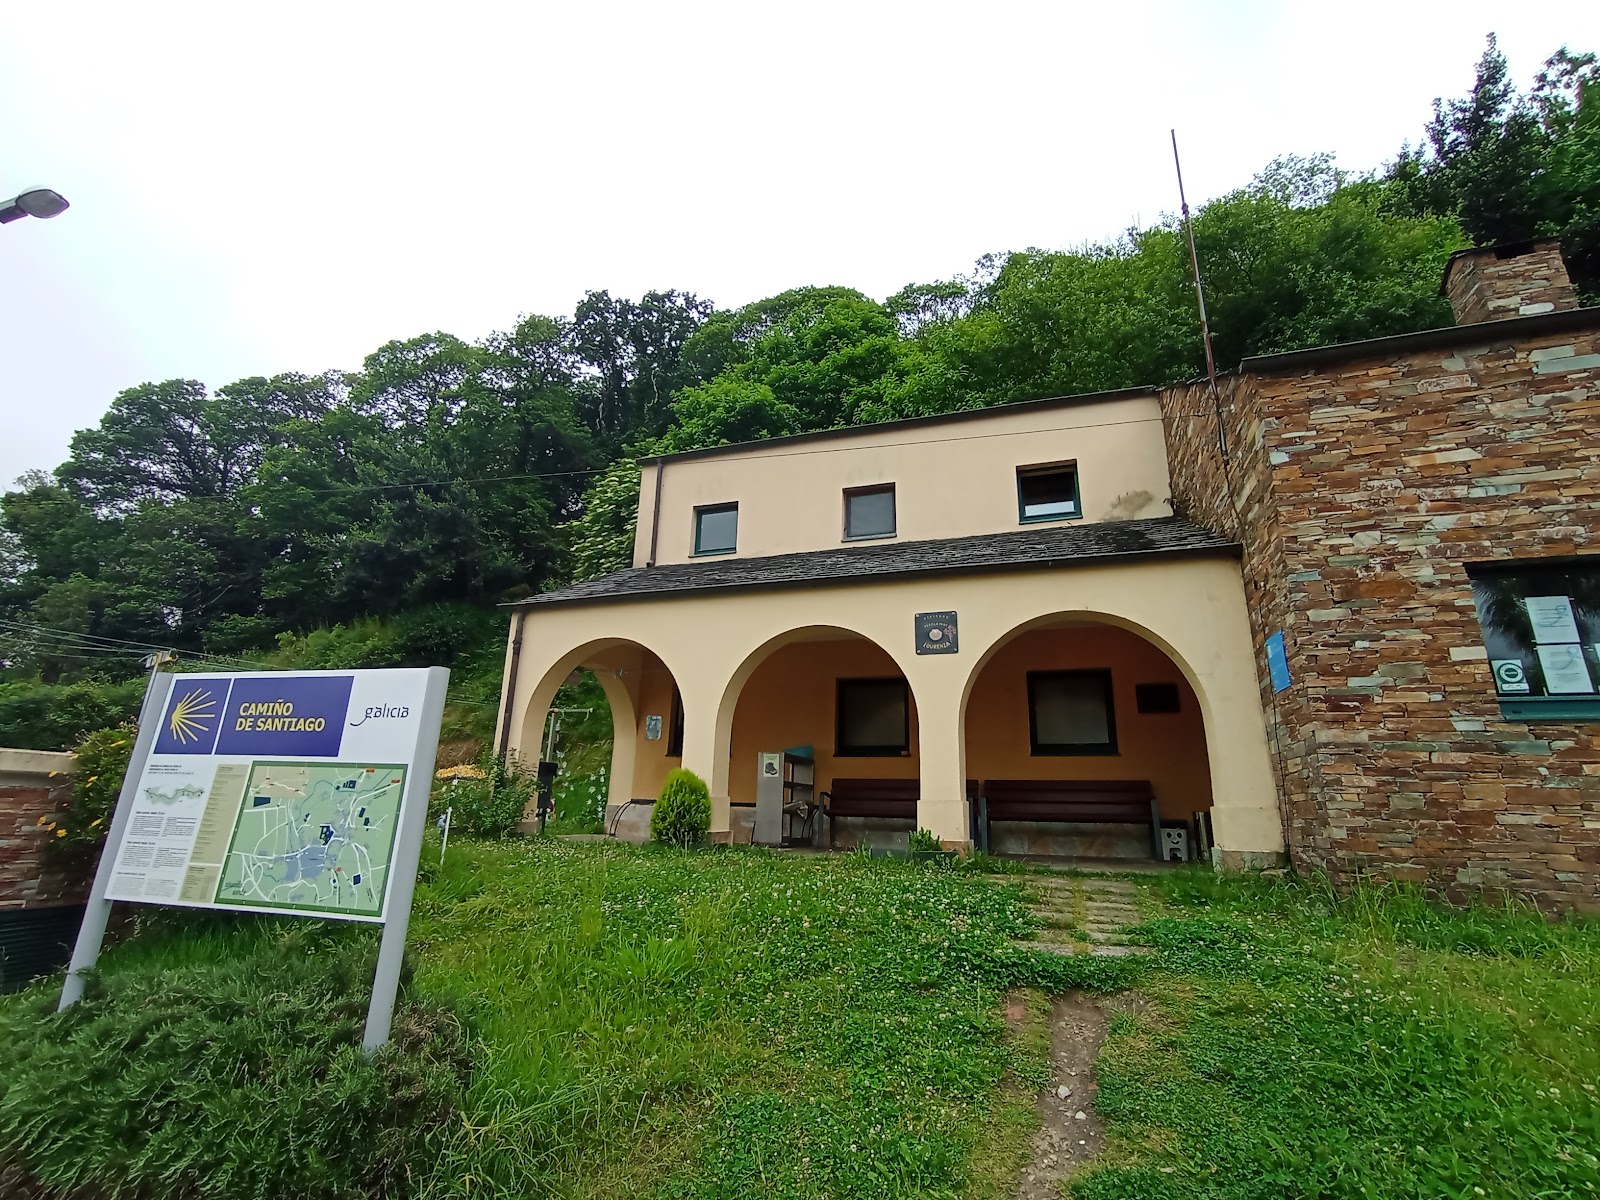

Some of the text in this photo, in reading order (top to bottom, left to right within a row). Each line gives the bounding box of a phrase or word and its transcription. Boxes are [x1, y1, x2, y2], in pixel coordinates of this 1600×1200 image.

[239, 698, 293, 716] CAMIÑO
[350, 703, 409, 727] galicia
[235, 718, 325, 732] DE SANTIAGO
